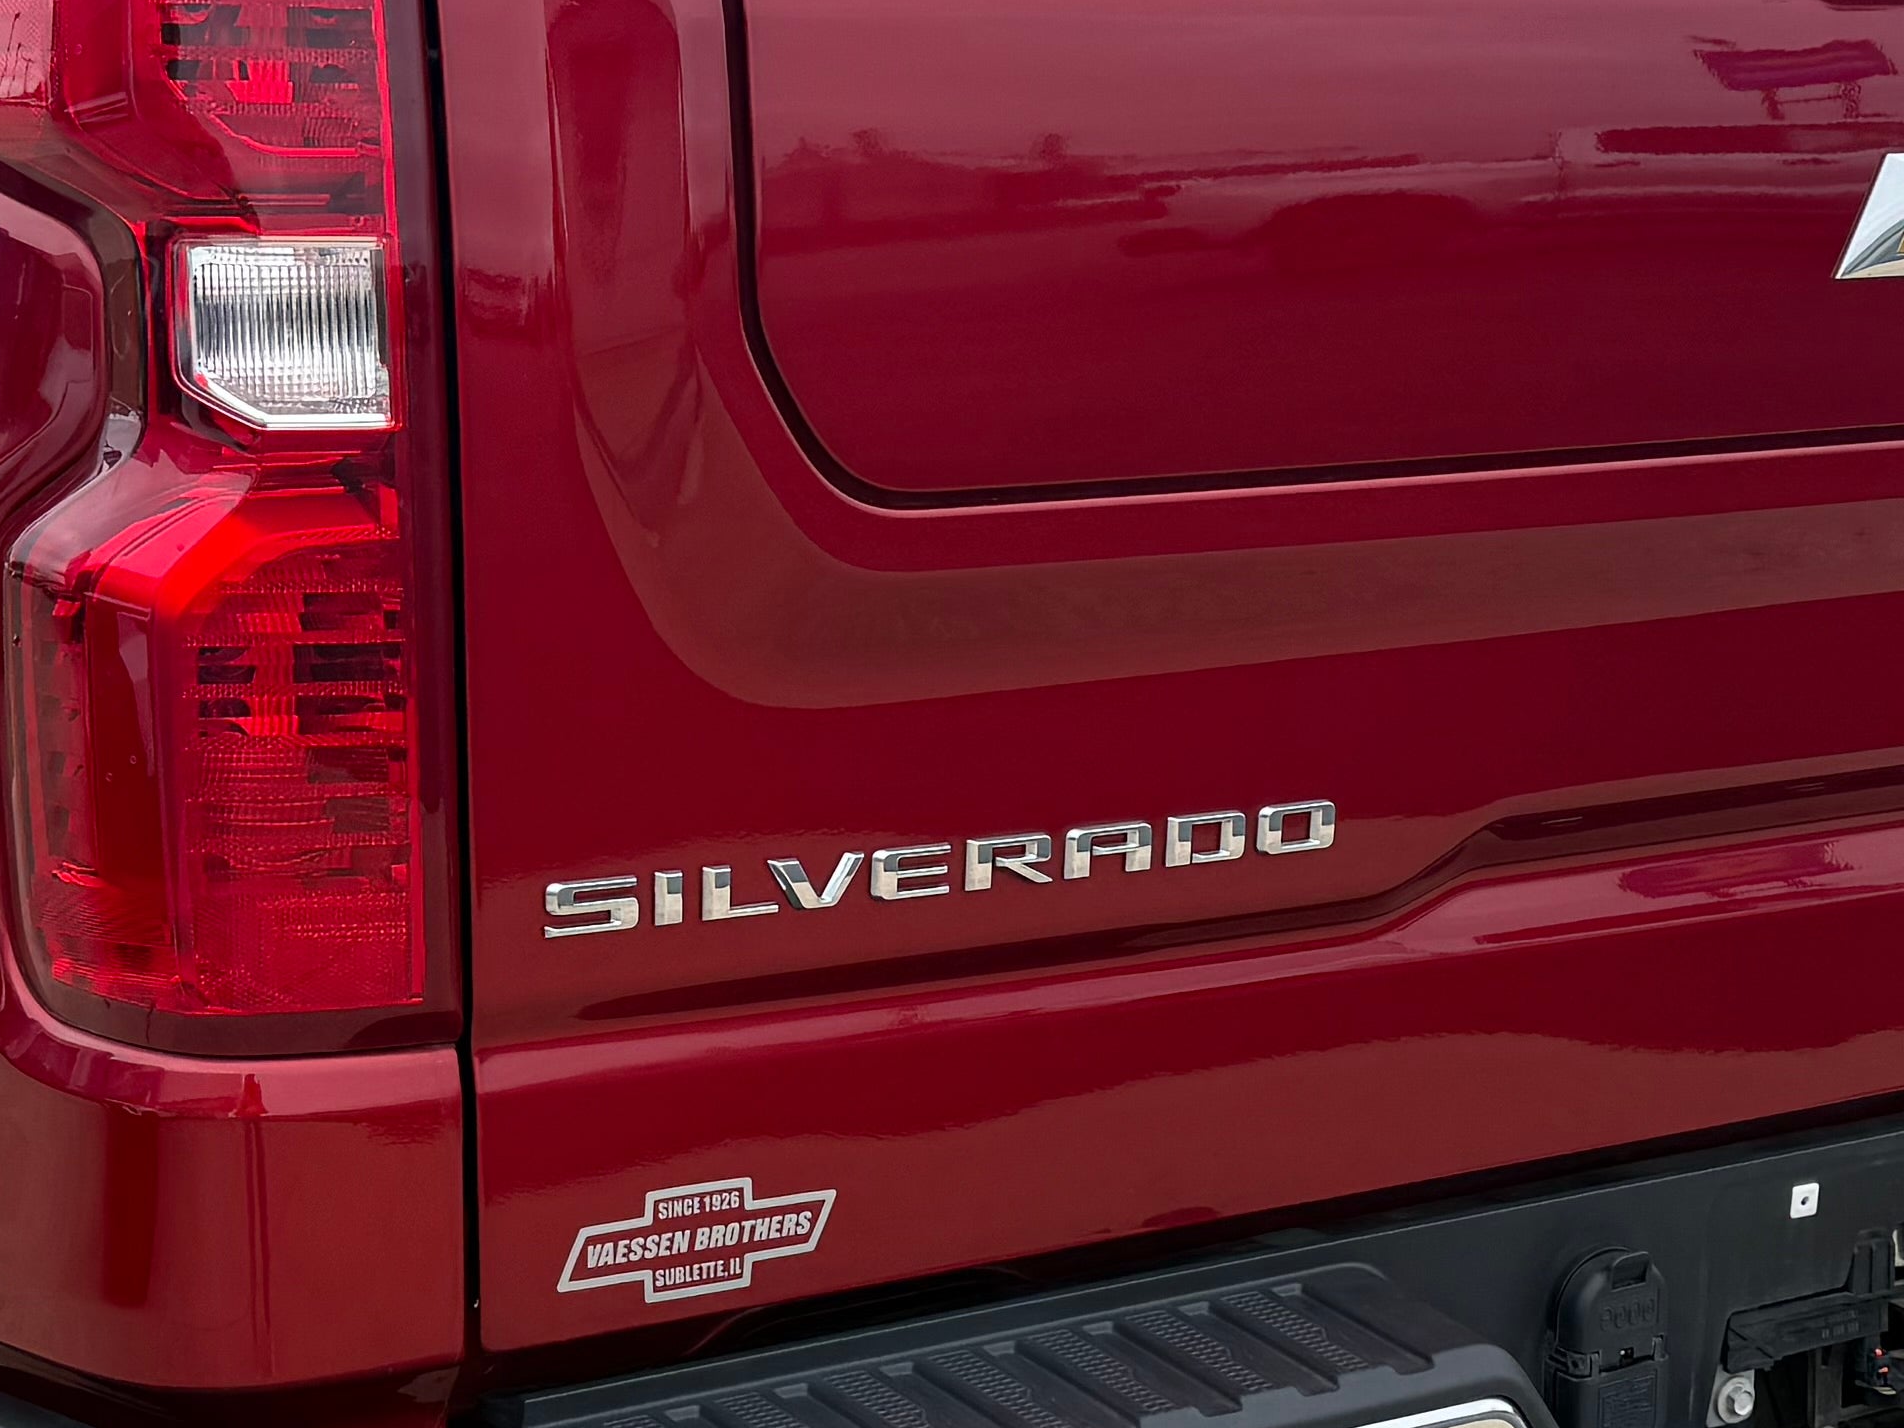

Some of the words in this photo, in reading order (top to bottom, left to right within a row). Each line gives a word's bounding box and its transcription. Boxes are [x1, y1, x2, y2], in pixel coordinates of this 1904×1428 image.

[543, 799, 1337, 939] SILVERADO
[658, 1196, 701, 1220] SINCE
[704, 1191, 740, 1212] 1926
[586, 1228, 691, 1269] VAESSEN
[695, 1211, 813, 1251] BROTHERS
[654, 1260, 728, 1289] SUBLETTE,
[729, 1257, 743, 1275] IL
